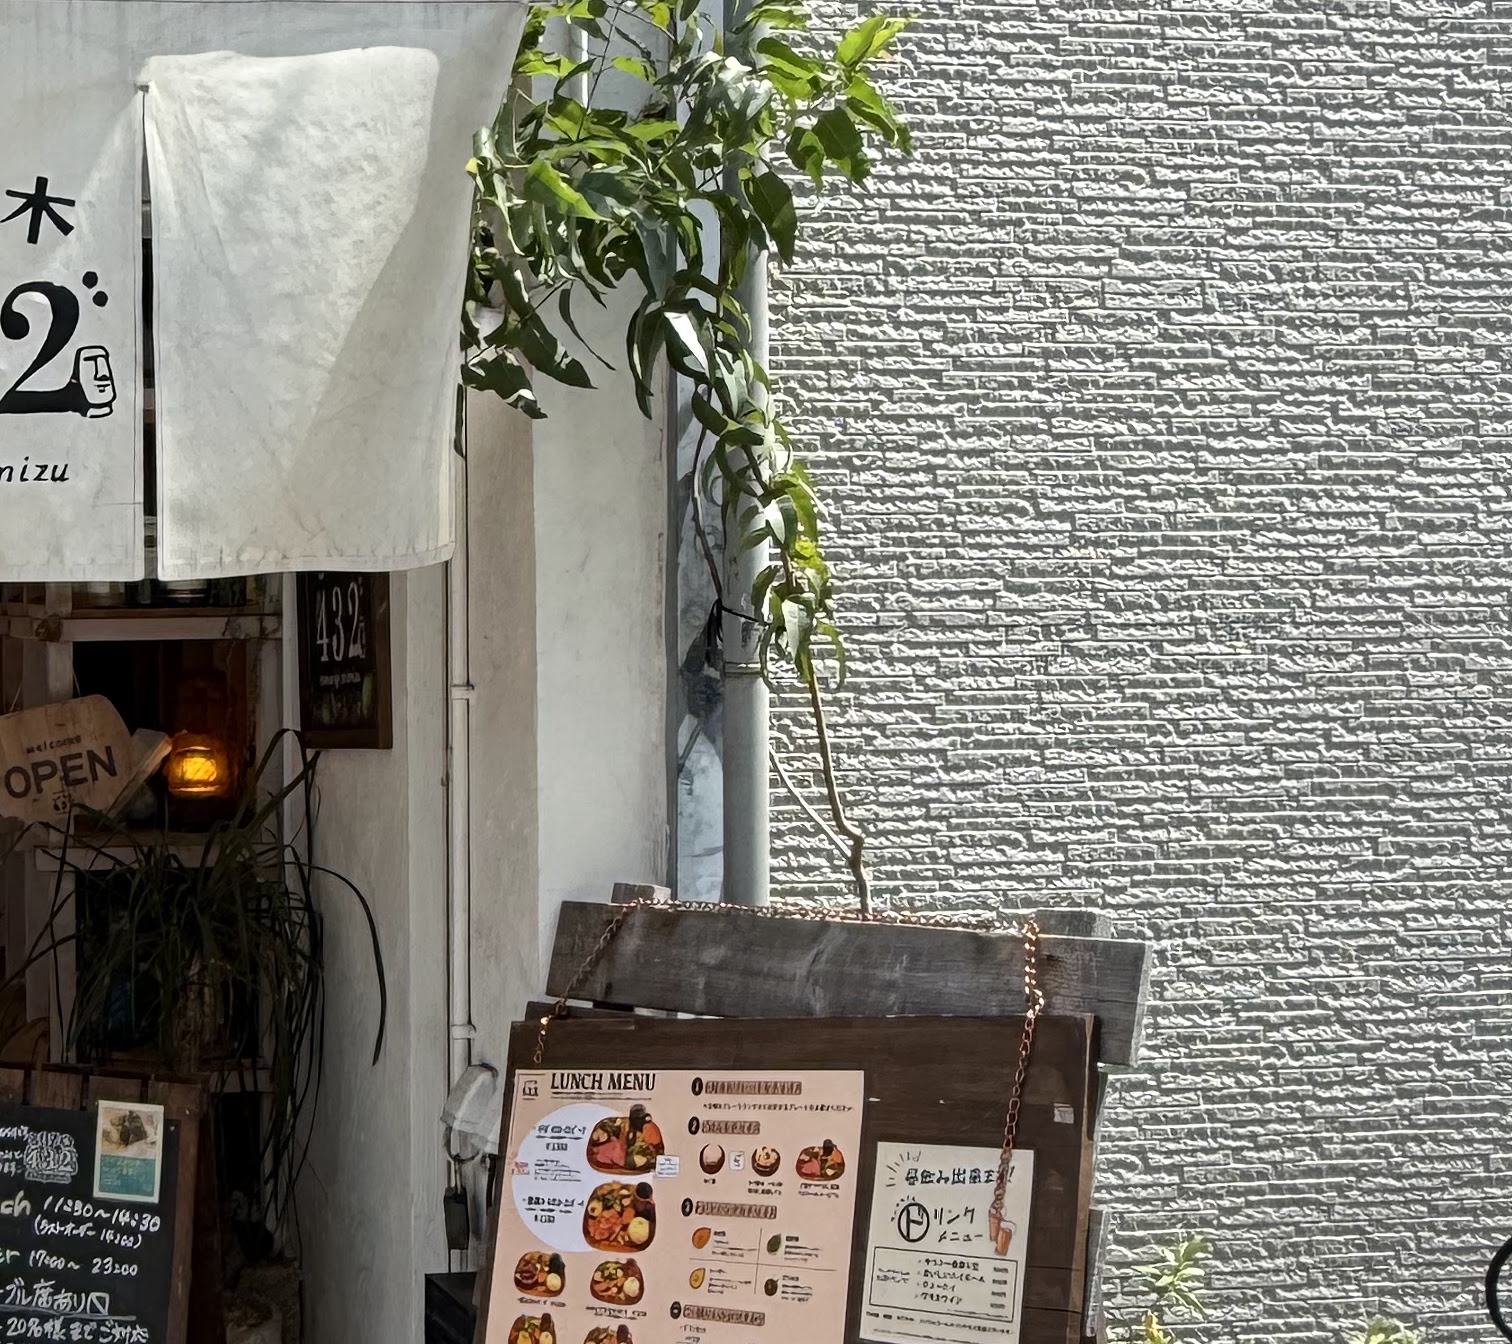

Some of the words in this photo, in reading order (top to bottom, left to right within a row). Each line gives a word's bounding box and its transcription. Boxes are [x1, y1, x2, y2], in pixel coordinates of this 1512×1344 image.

[4, 745, 118, 799] OPEN
[550, 1072, 603, 1091] LUNCH
[607, 1072, 657, 1092] MENU
